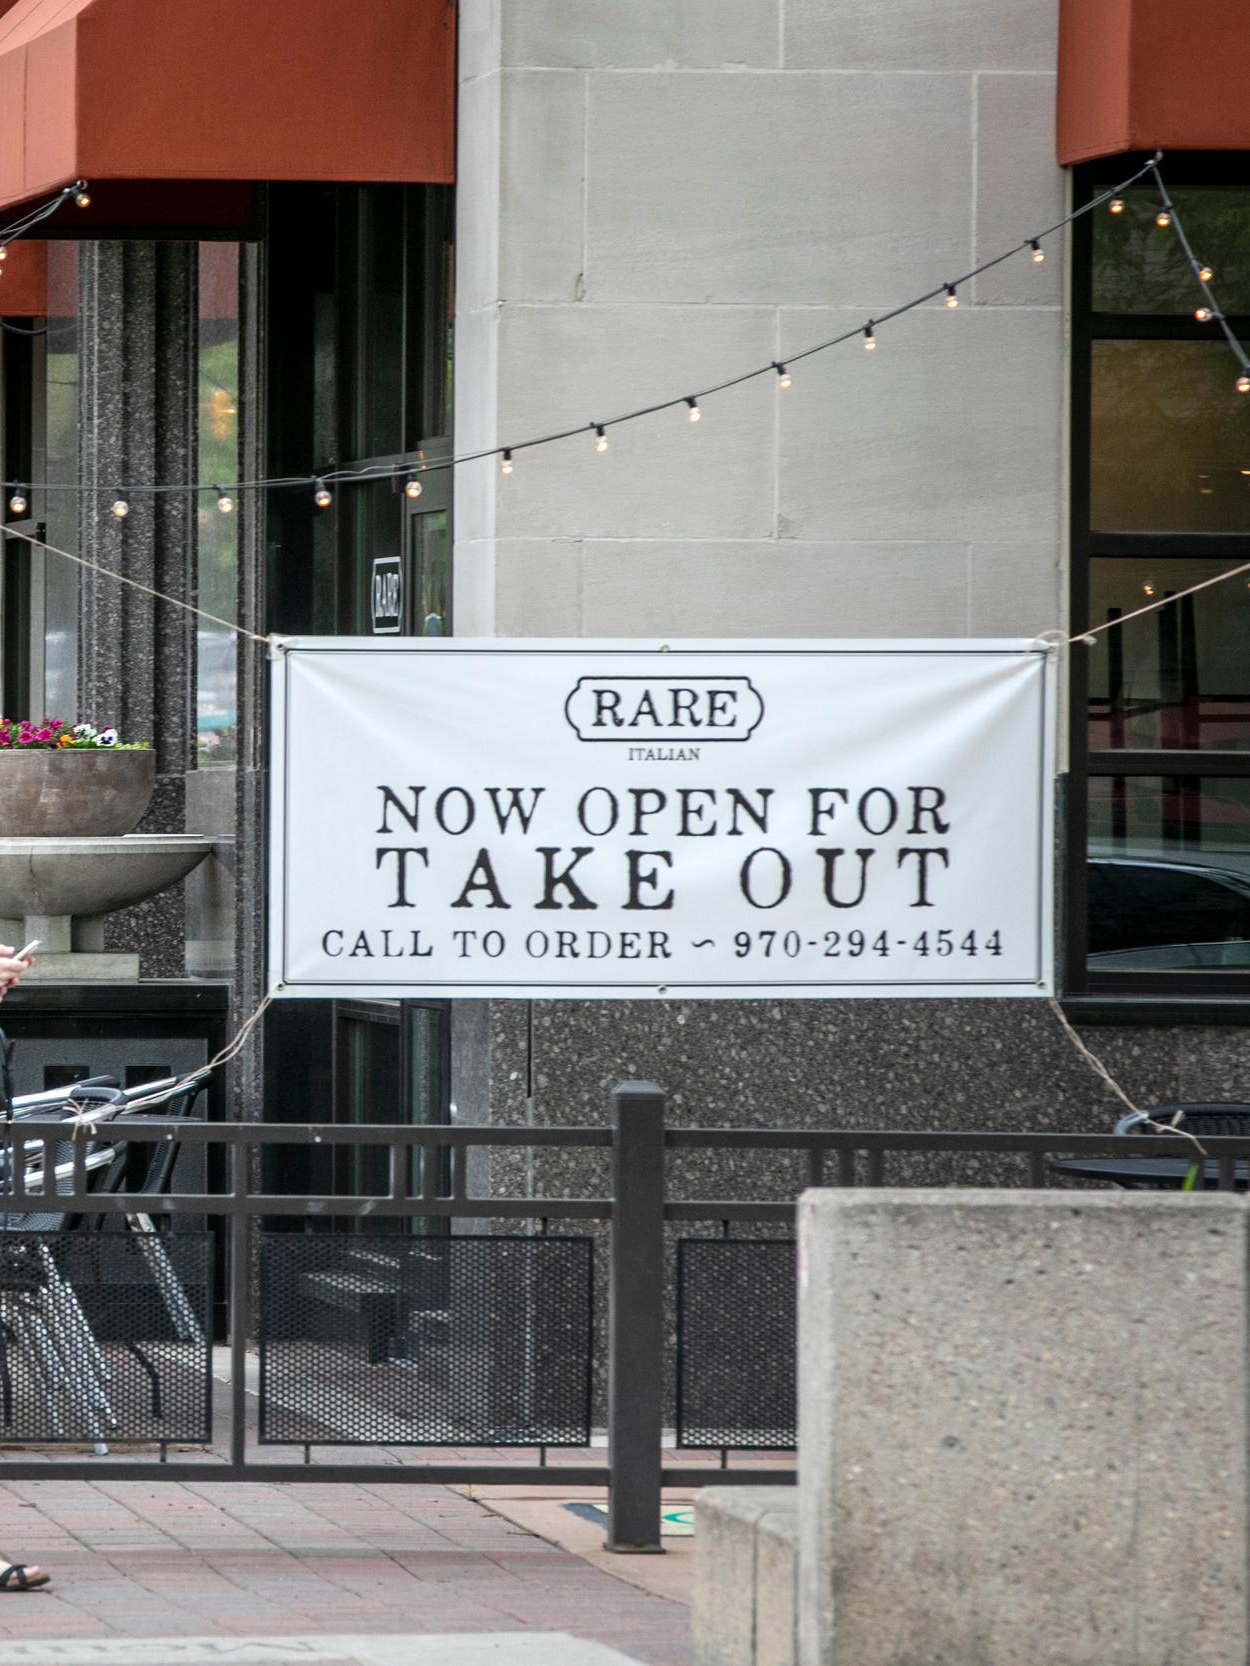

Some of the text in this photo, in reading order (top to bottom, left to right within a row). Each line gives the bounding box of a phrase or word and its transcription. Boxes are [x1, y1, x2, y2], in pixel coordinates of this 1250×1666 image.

[591, 688, 738, 728] RARE
[628, 747, 701, 761] ITALIAN
[375, 785, 951, 838] NOW OPEN FOR
[375, 845, 951, 911] TAKE OUT
[321, 929, 434, 958] CALL
[452, 929, 506, 959] TO
[524, 930, 673, 960] ORDER
[733, 928, 1004, 959] 970-294-4544
